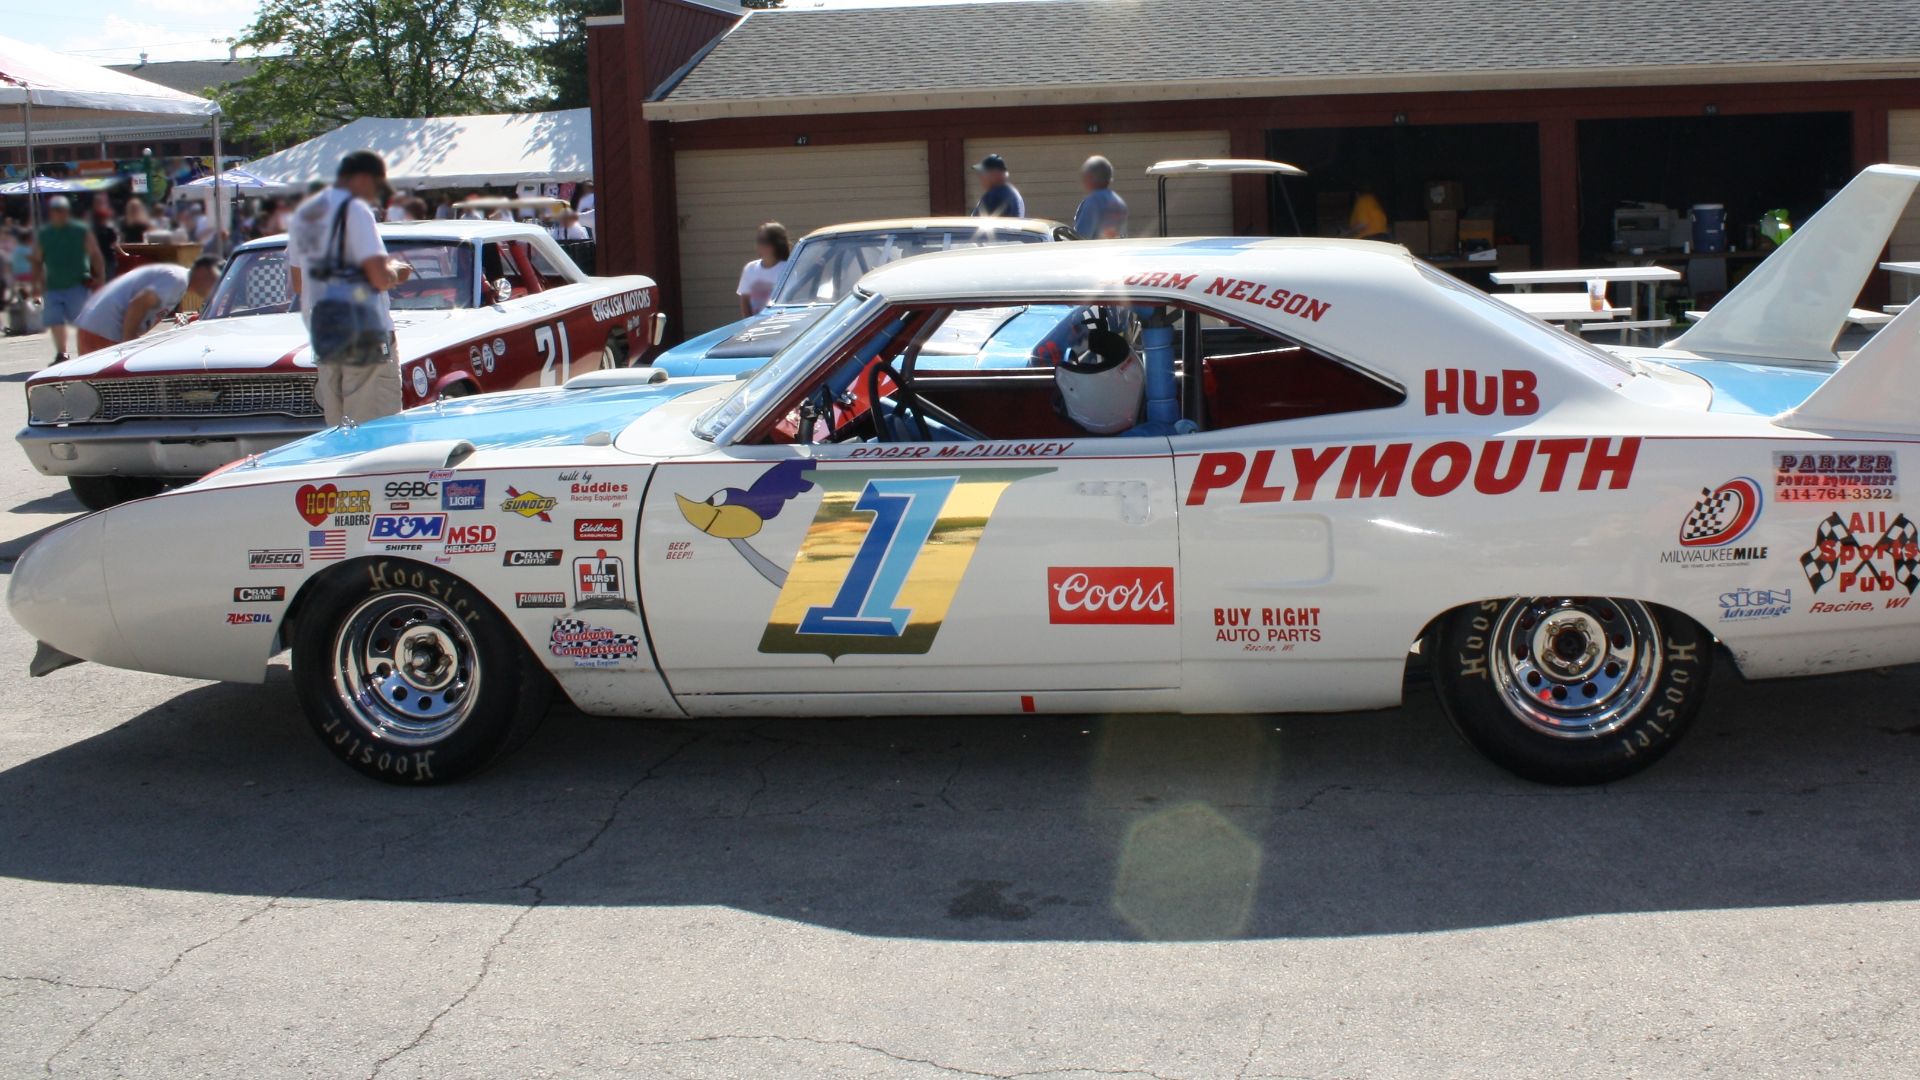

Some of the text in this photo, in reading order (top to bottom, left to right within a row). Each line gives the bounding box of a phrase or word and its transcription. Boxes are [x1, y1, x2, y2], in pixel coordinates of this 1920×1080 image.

[1112, 271, 1332, 322] ORM NELSON
[592, 289, 650, 322] ENGLISH MOTORS
[535, 321, 570, 387] 21
[1425, 368, 1539, 415] HUB
[1185, 435, 1643, 505] PLYMOUTH
[1779, 454, 1893, 473] PARKER
[581, 470, 592, 484] by
[1776, 475, 1897, 487] POWER EQUIPMENT
[385, 482, 438, 497] SSBC
[571, 482, 628, 493] Buddies
[1780, 488, 1893, 500] 414-764-3322
[306, 490, 371, 515] HOOKER
[449, 496, 476, 506] LIGHT
[504, 499, 553, 510] SUNOCO
[571, 494, 628, 502] Racing Equipment
[334, 515, 370, 527] HEADERS
[372, 516, 444, 538] B&M
[580, 523, 617, 532] Edelbrock
[1848, 511, 1886, 533] All
[447, 525, 496, 544] MSD
[445, 543, 495, 553] HELI-CORE
[668, 542, 691, 550] BEEP
[1820, 540, 1919, 565] Sports
[251, 553, 301, 563] WISECO
[510, 551, 554, 565] CRANE
[666, 551, 694, 560] BEEP!!
[796, 475, 960, 637] 1
[583, 574, 615, 582] HURST
[1840, 571, 1894, 593] Pub
[240, 588, 278, 600] CRANE
[368, 561, 480, 623] Hoosier
[1053, 573, 1168, 611] Coors
[519, 594, 564, 606] FLOWMASTER
[1809, 597, 1911, 614] Racine, WI
[226, 613, 272, 624] AMSOIL
[1214, 608, 1320, 626] BUY RIGHT
[1721, 604, 1791, 619] Advantage
[552, 624, 615, 643] Goodwin
[1216, 629, 1321, 642] AUTO PARTS
[551, 643, 635, 658] Competition
